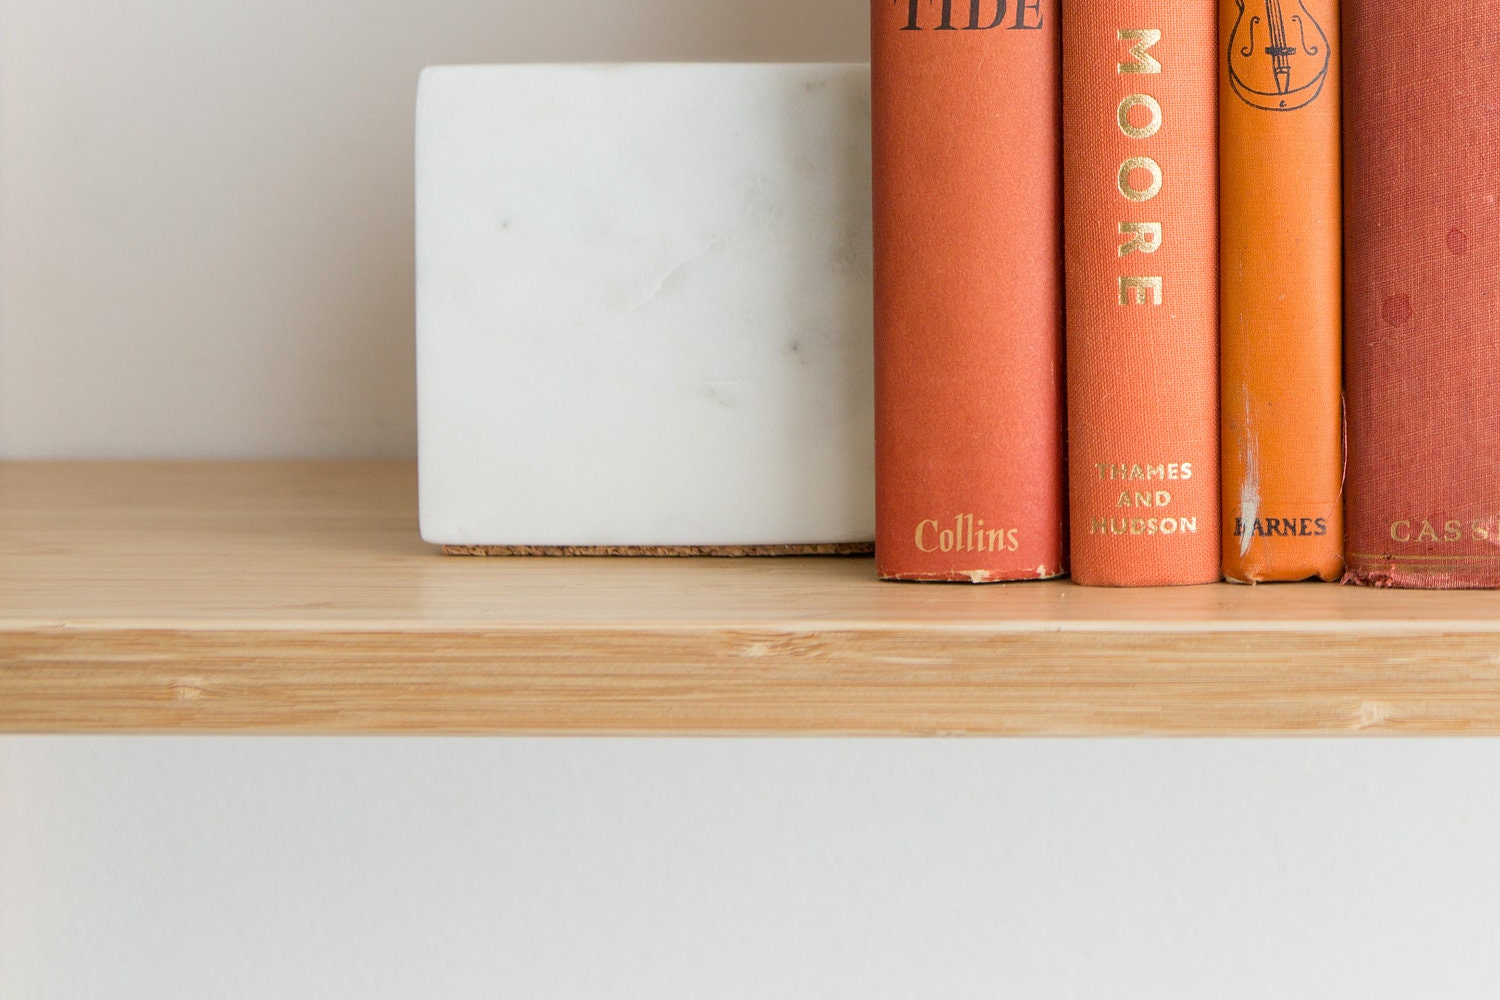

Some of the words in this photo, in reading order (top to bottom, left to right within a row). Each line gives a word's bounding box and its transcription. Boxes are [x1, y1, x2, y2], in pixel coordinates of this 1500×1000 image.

[1116, 28, 1164, 306] MOORE
[1094, 462, 1193, 481] THAMES
[1117, 490, 1171, 508] AND
[914, 512, 1019, 554] Collins
[1091, 516, 1197, 536] HUDSON
